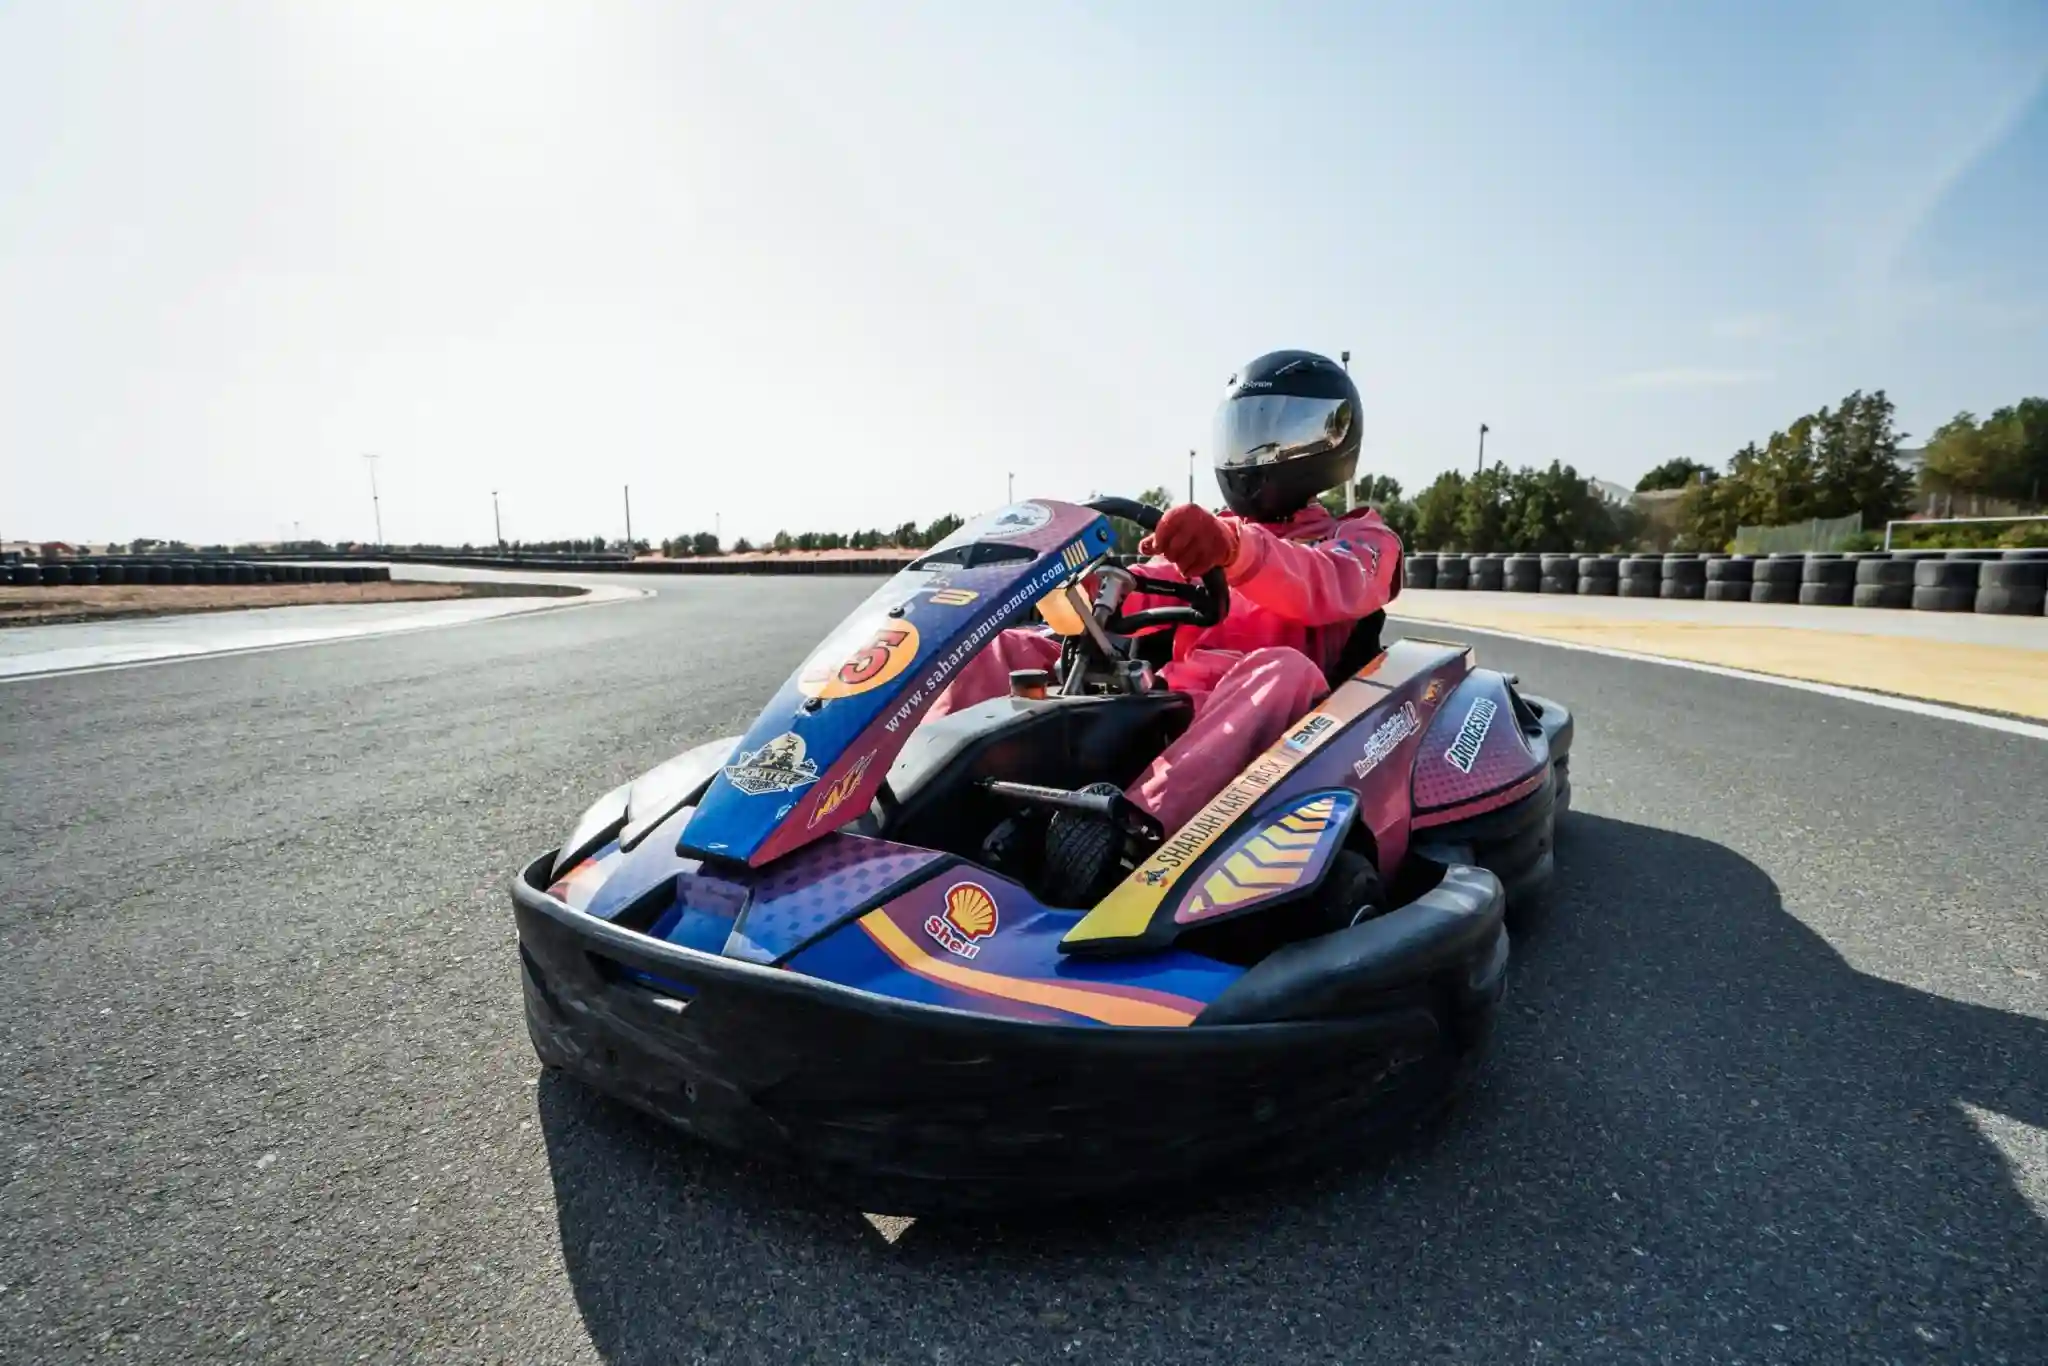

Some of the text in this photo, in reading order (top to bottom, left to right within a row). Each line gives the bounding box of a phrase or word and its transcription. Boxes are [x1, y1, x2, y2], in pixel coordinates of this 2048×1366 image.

[885, 561, 1065, 733] www.saharaamusement.com
[1447, 697, 1496, 772] BRIDGESTONE
[1156, 760, 1287, 867] SHARJAH KART TRACK
[926, 917, 979, 958] Shell
